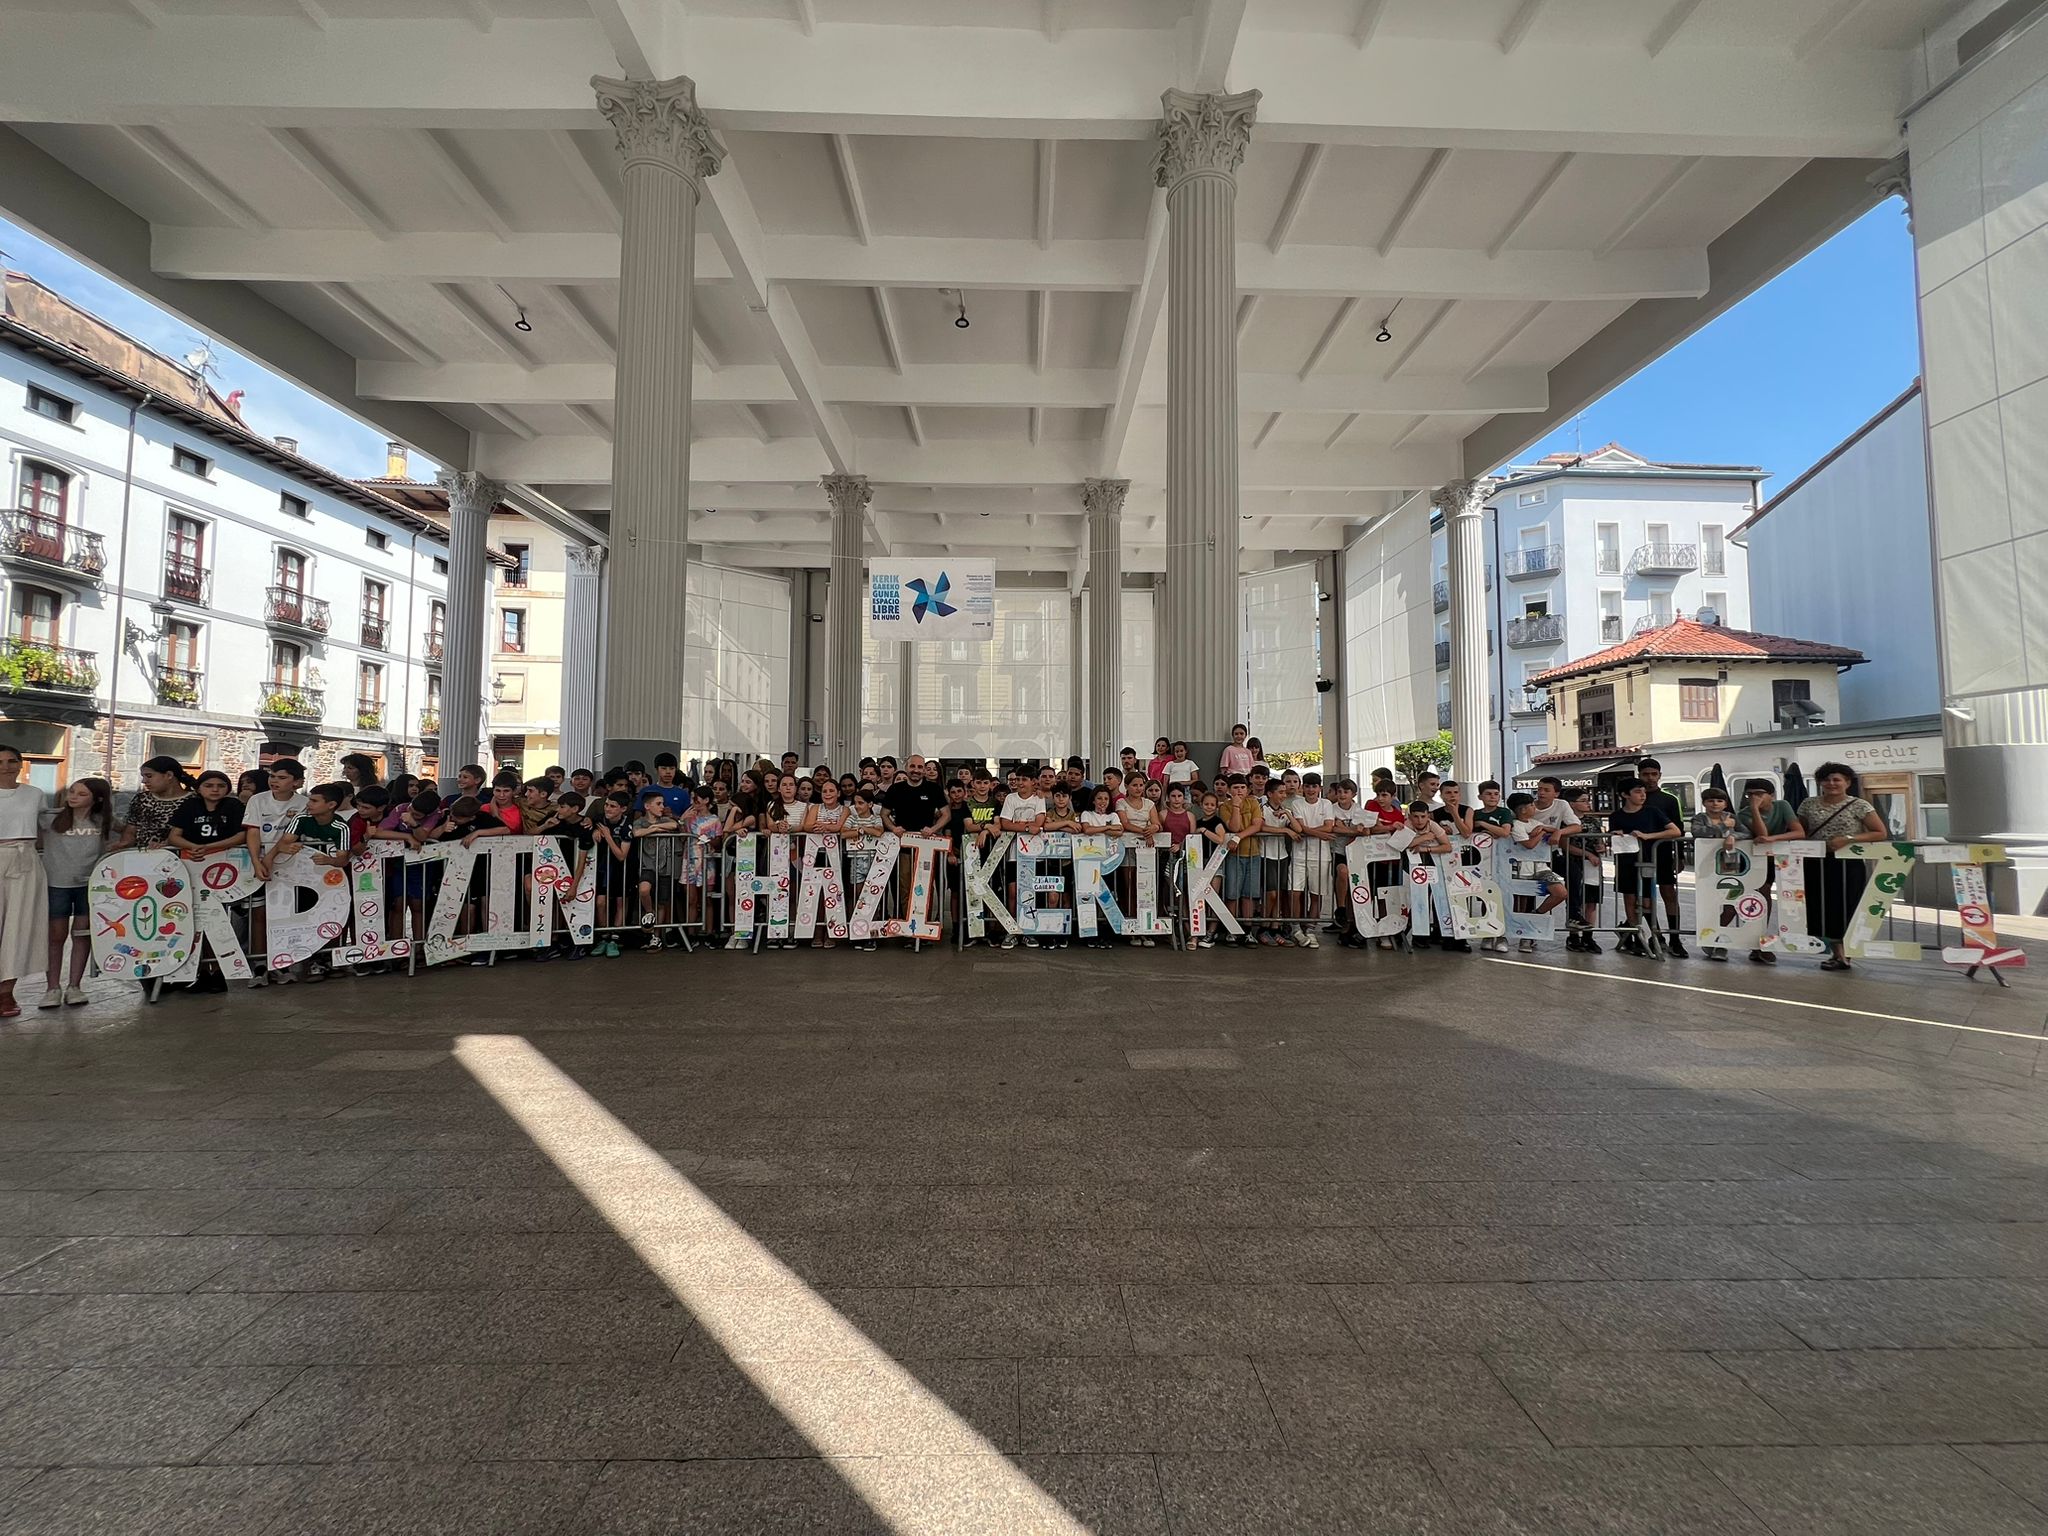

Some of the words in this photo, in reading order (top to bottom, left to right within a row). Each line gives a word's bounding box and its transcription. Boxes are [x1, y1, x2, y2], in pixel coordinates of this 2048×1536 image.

[872, 590, 900, 598] GUNEA
[872, 604, 900, 614] LIBRE
[1845, 745, 1918, 759] enedur
[1516, 780, 1539, 789] ETXE
[1560, 778, 1593, 788] Taberna
[972, 807, 995, 821] NIKE
